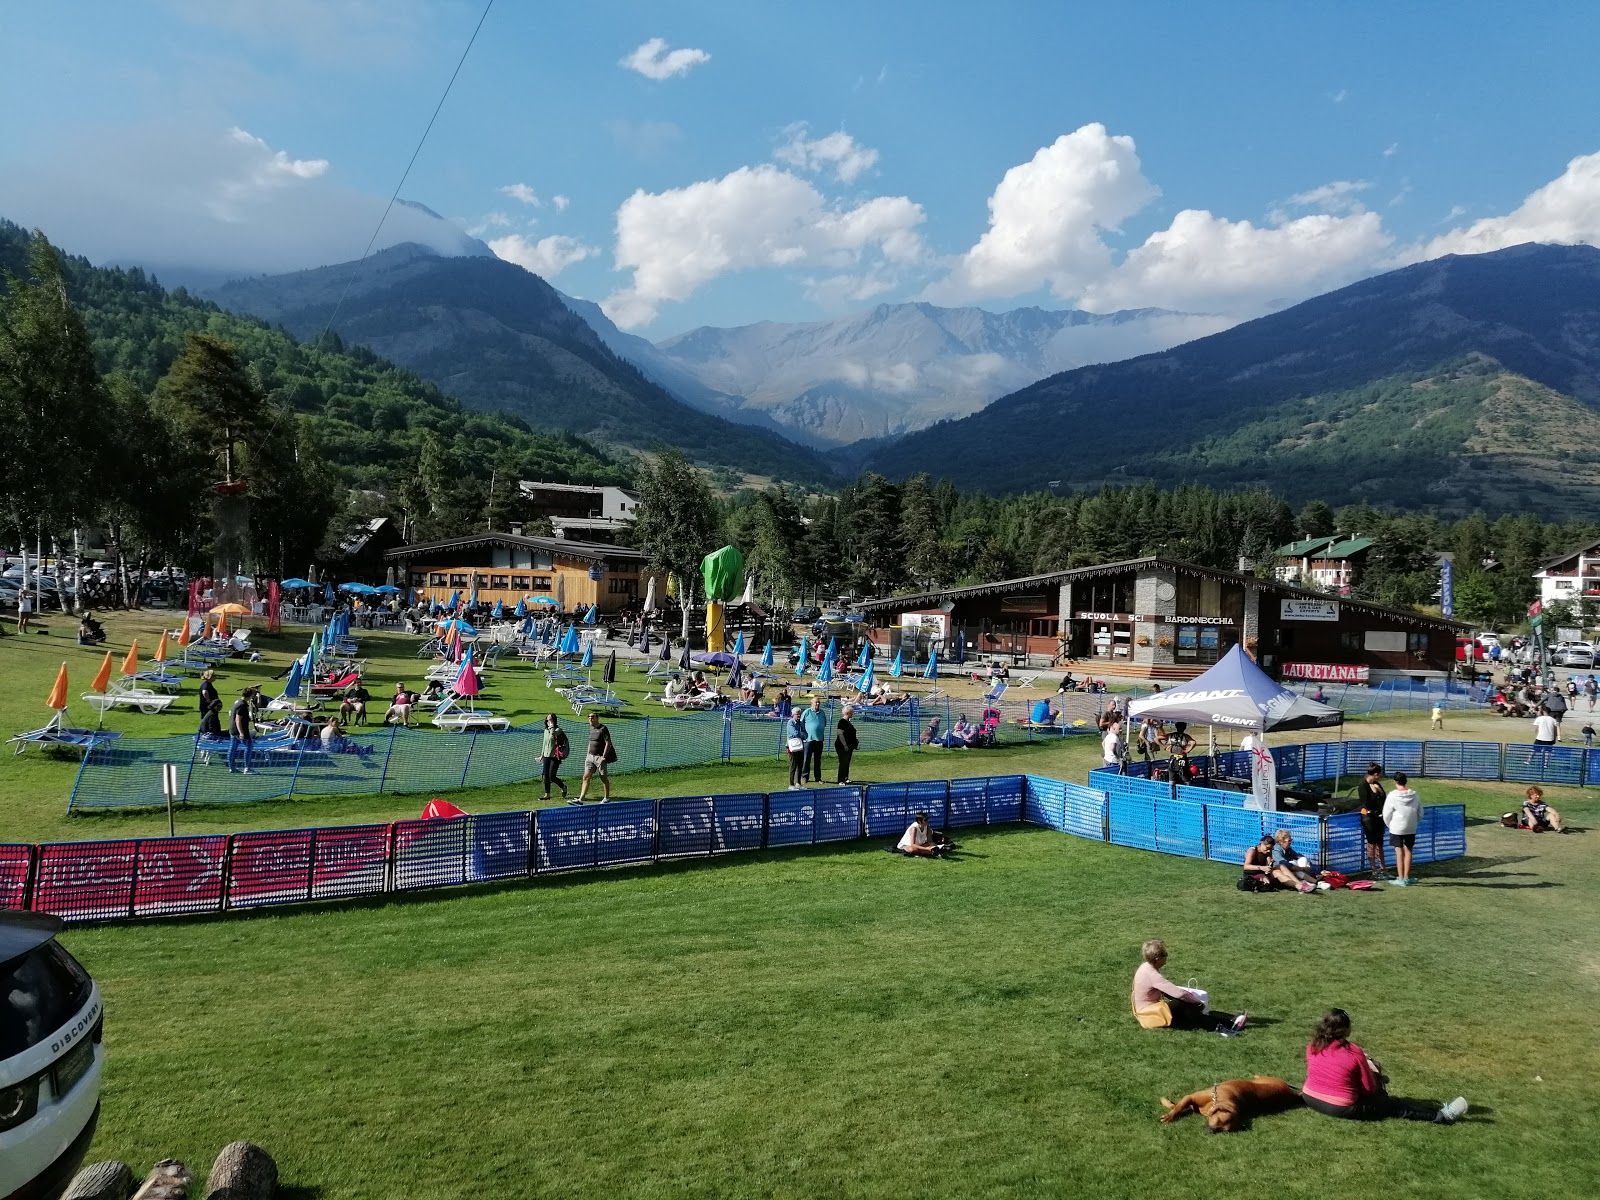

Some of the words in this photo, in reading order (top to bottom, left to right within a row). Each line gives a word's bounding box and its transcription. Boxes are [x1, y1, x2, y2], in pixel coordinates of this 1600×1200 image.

[1081, 612, 1119, 621] SCUOLA
[1128, 614, 1144, 622] SCI
[1165, 615, 1234, 625] BARDONECCHIA
[1282, 664, 1356, 680] LAURETANA
[1166, 689, 1245, 701] GIANT
[1220, 716, 1257, 726] GIANT
[51, 1002, 99, 1053] DISCOVERY
